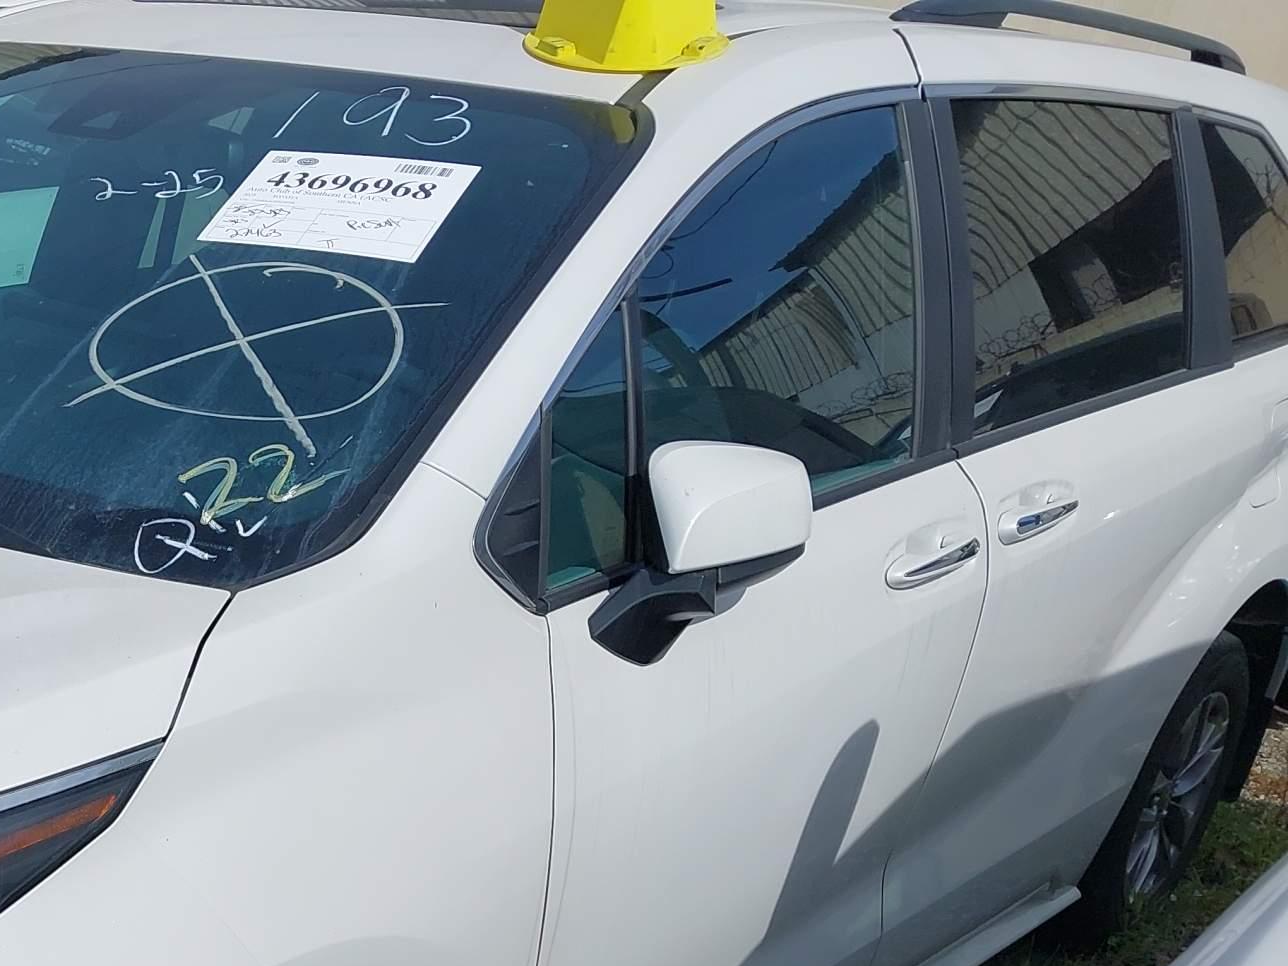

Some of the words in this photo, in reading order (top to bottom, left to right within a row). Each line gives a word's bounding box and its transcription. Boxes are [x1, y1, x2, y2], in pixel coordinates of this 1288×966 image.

[273, 87, 472, 146] 193
[90, 168, 224, 200] 2-25
[267, 171, 437, 200] 43696968
[177, 443, 352, 525] 22
